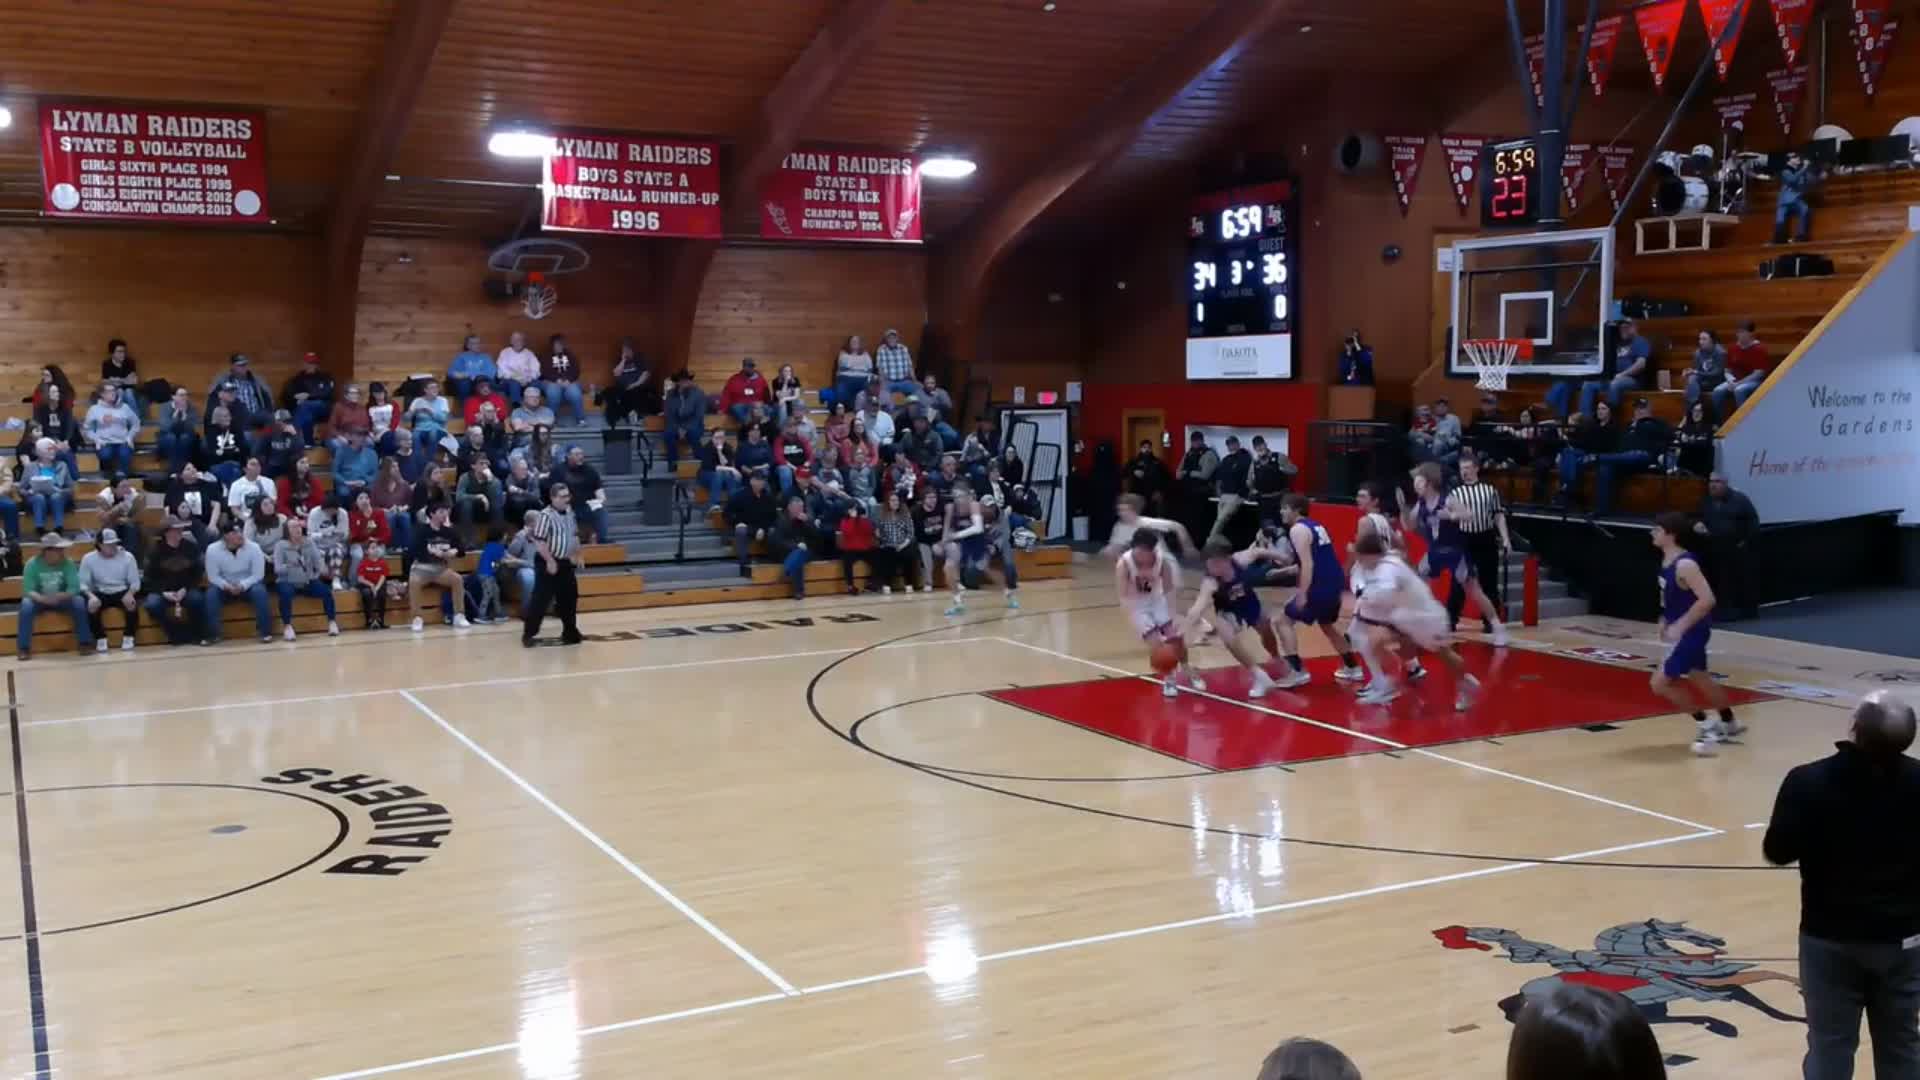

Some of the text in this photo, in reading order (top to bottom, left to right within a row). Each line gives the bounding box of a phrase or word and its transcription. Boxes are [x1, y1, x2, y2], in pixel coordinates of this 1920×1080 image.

[52, 109, 252, 140] LYMAN RAIDERS
[60, 136, 247, 159] STATE B VOLLEYBALL
[551, 137, 713, 165] LYMAN RAIDERS
[80, 159, 229, 176] GIRLS SIXTH PLACE 1994
[781, 153, 913, 176] YMAN RAIDERS
[1494, 147, 1536, 176] 6:59
[79, 174, 115, 187] GIRLS
[118, 175, 162, 189] EIGHTH
[165, 177, 202, 190] PLACE
[578, 166, 690, 187] BOYS STATE A
[815, 175, 869, 190] STATE B
[80, 187, 233, 203] GIRLS EIGHTH PLACE 2012
[641, 189, 720, 205] RUNNER-UP
[804, 188, 881, 204] BOYS TRACK
[1491, 175, 1528, 218] 23
[81, 200, 233, 216] CONSOLATION CHAMPS 2013
[804, 207, 854, 219] CHAMPION
[611, 209, 660, 231] 1996
[801, 219, 857, 231] RUNNER-UP
[1222, 204, 1262, 239] 6:59
[1193, 261, 1217, 291] 34
[1231, 260, 1242, 285] 3
[1262, 252, 1288, 285] 36
[1197, 302, 1204, 322] 1
[1274, 294, 1287, 319] 0
[1808, 384, 1912, 408] Welcome to the
[1820, 413, 1912, 437] Gardens
[1749, 449, 1789, 477] Home
[261, 768, 452, 876] RAIDERS
